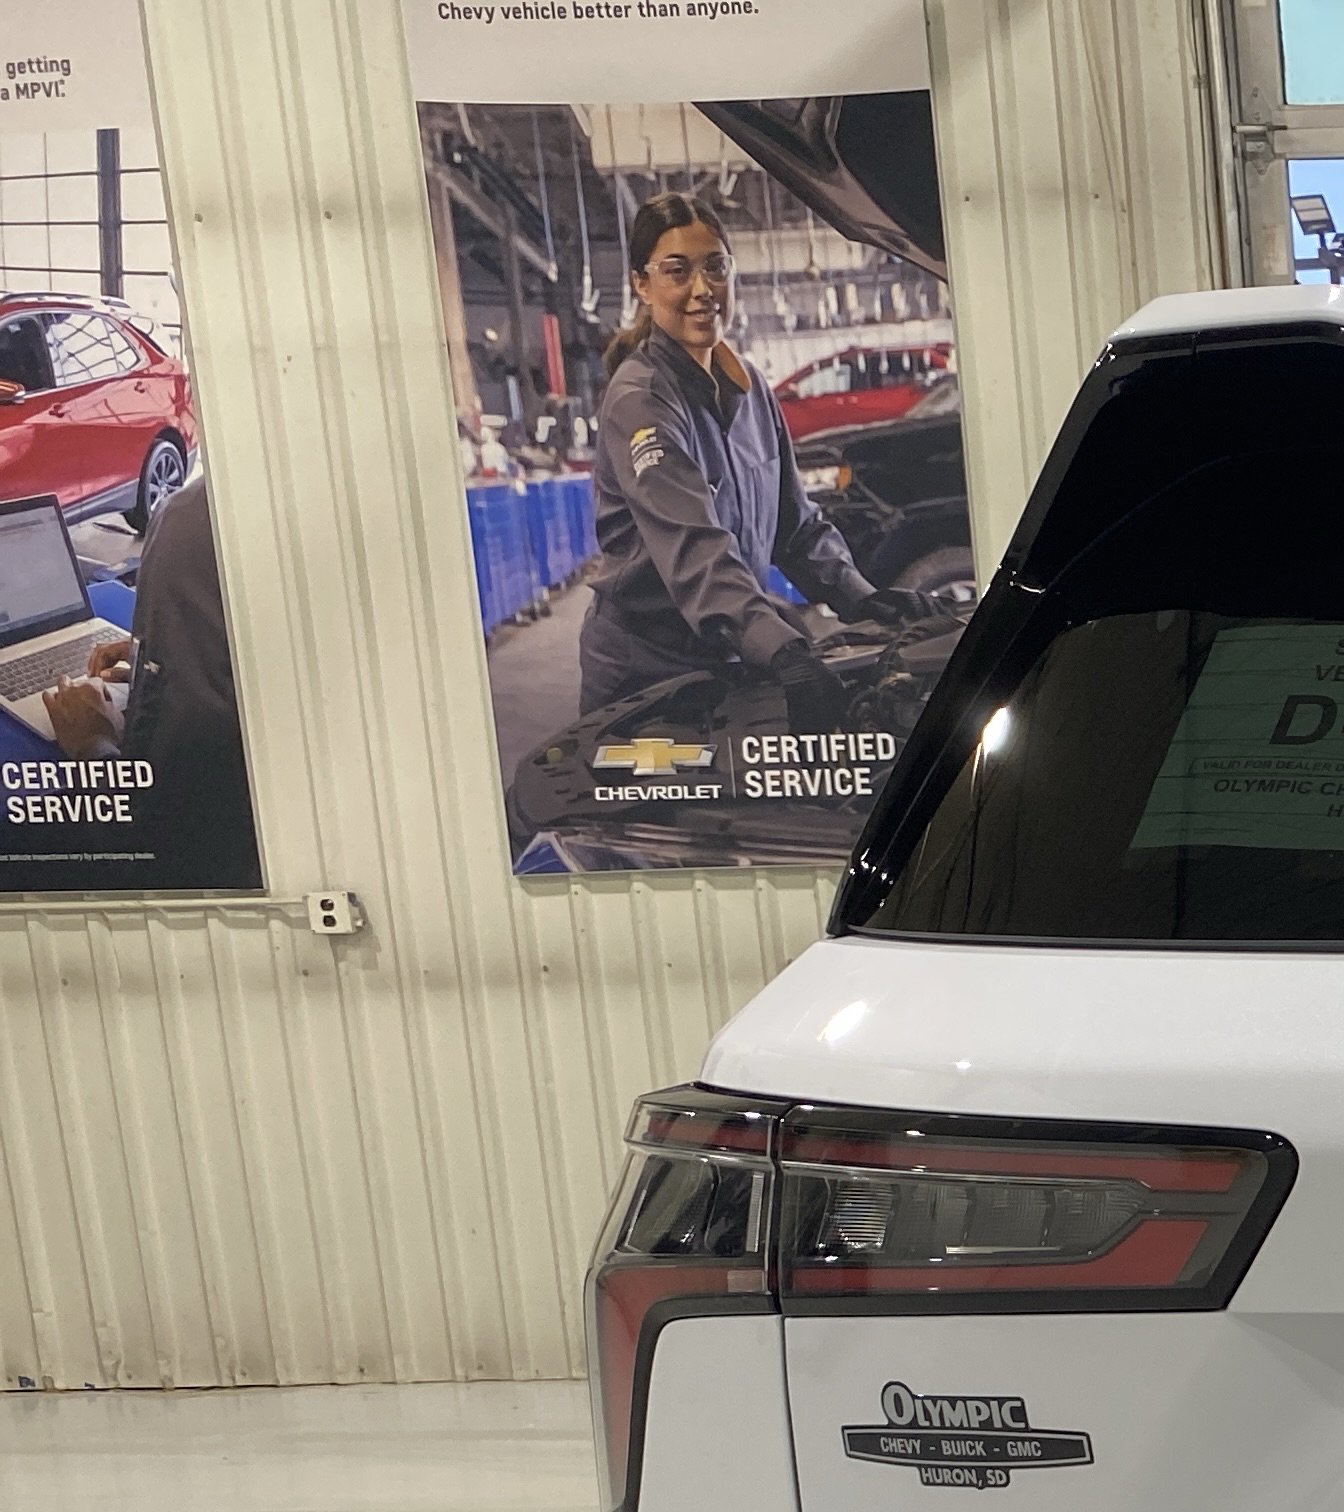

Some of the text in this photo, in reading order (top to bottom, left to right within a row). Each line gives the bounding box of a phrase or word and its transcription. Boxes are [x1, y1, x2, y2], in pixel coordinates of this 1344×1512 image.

[437, 0, 760, 24] Chevy vehicle better than anyone.
[6, 56, 71, 79] getting
[0, 87, 10, 100] a
[741, 733, 896, 764] CERTIFIED
[1, 760, 154, 789] CERTIFIED
[1203, 760, 1241, 770] VALID
[1244, 760, 1272, 770] FOR
[1275, 760, 1332, 772] DEALER
[594, 784, 722, 800] CHEVROLET
[744, 768, 873, 797] SERVICE
[1213, 779, 1312, 795] OLYMPIC
[6, 794, 133, 824] SERVICE
[883, 1383, 1026, 1428] OLYMPIC
[879, 1437, 921, 1455] CHEVY
[942, 1440, 987, 1456] BUICK
[1007, 1441, 1042, 1457] GMC
[920, 1467, 1008, 1486] HURON, SD
